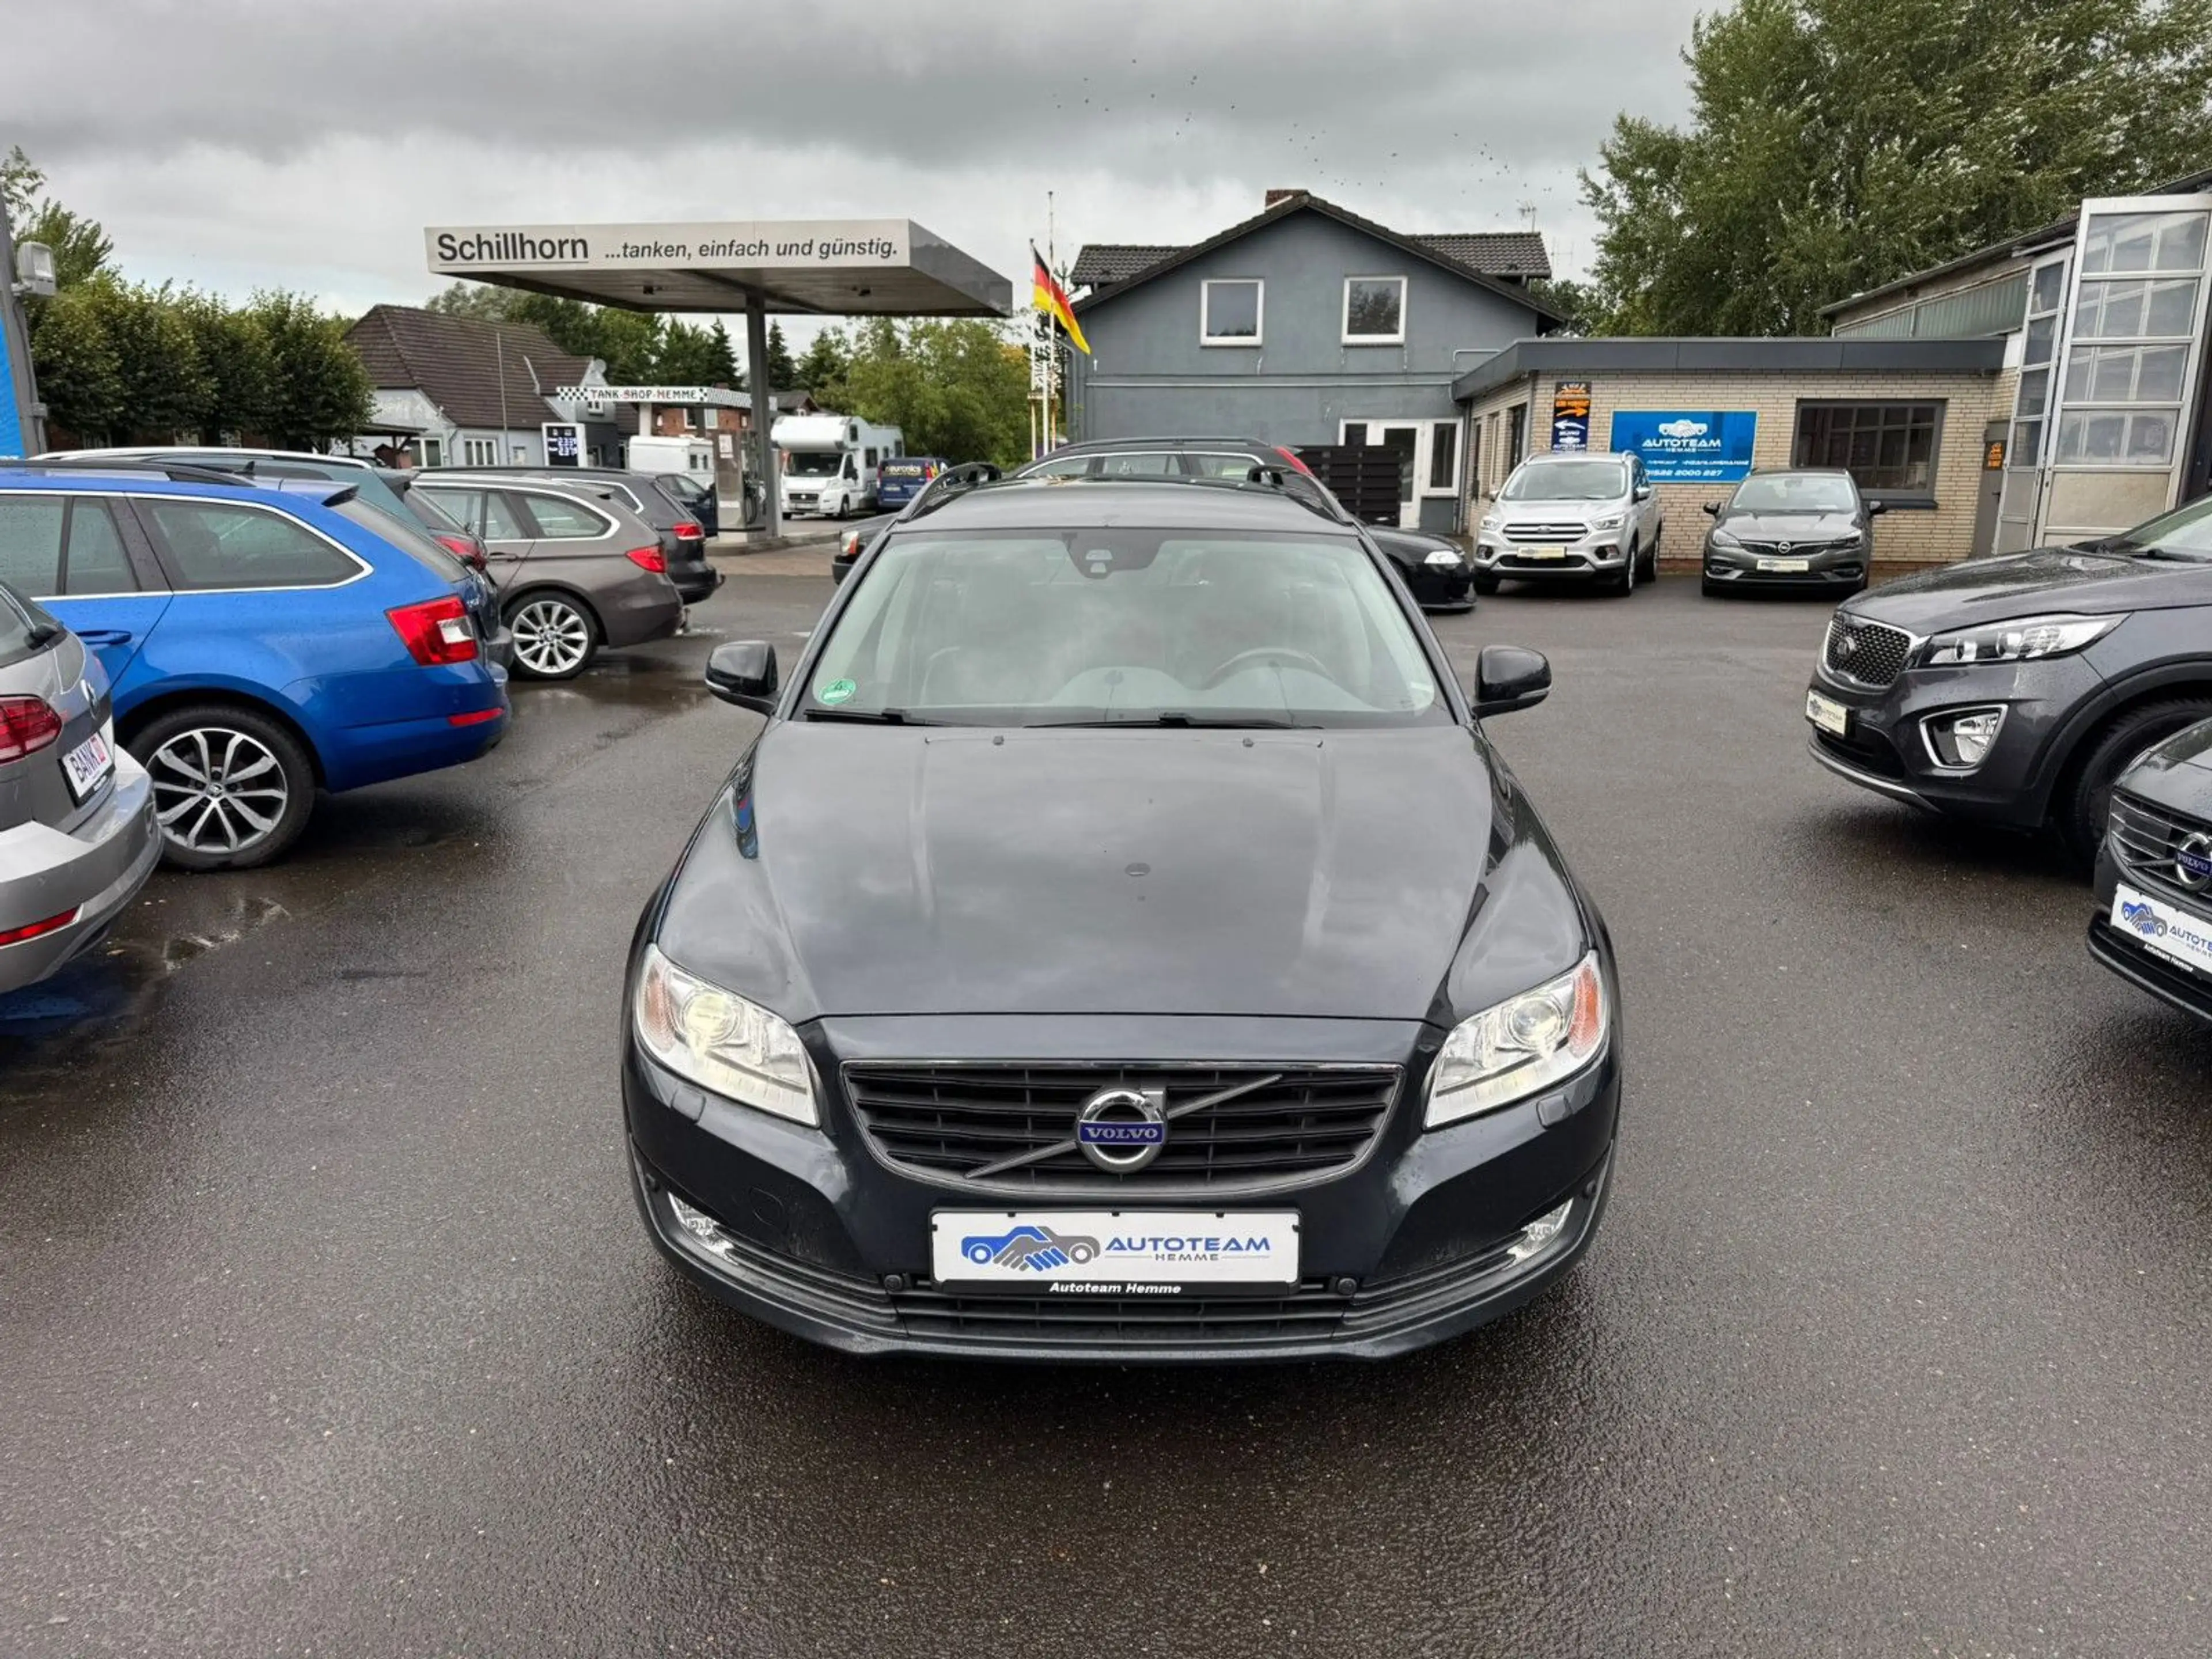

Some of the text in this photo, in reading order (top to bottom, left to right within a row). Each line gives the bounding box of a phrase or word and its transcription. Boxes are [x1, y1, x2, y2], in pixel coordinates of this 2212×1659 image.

[437, 232, 898, 261] Schillhorn ...tanken, einfach und günstig.
[1642, 438, 1721, 448] AUTOTEAM
[1085, 1127, 1158, 1140] VOLVO
[1105, 1237, 1271, 1252] AUTOTEAM
[1155, 1253, 1219, 1262] HEMME
[1049, 1282, 1182, 1295] Autoteam Hemme
